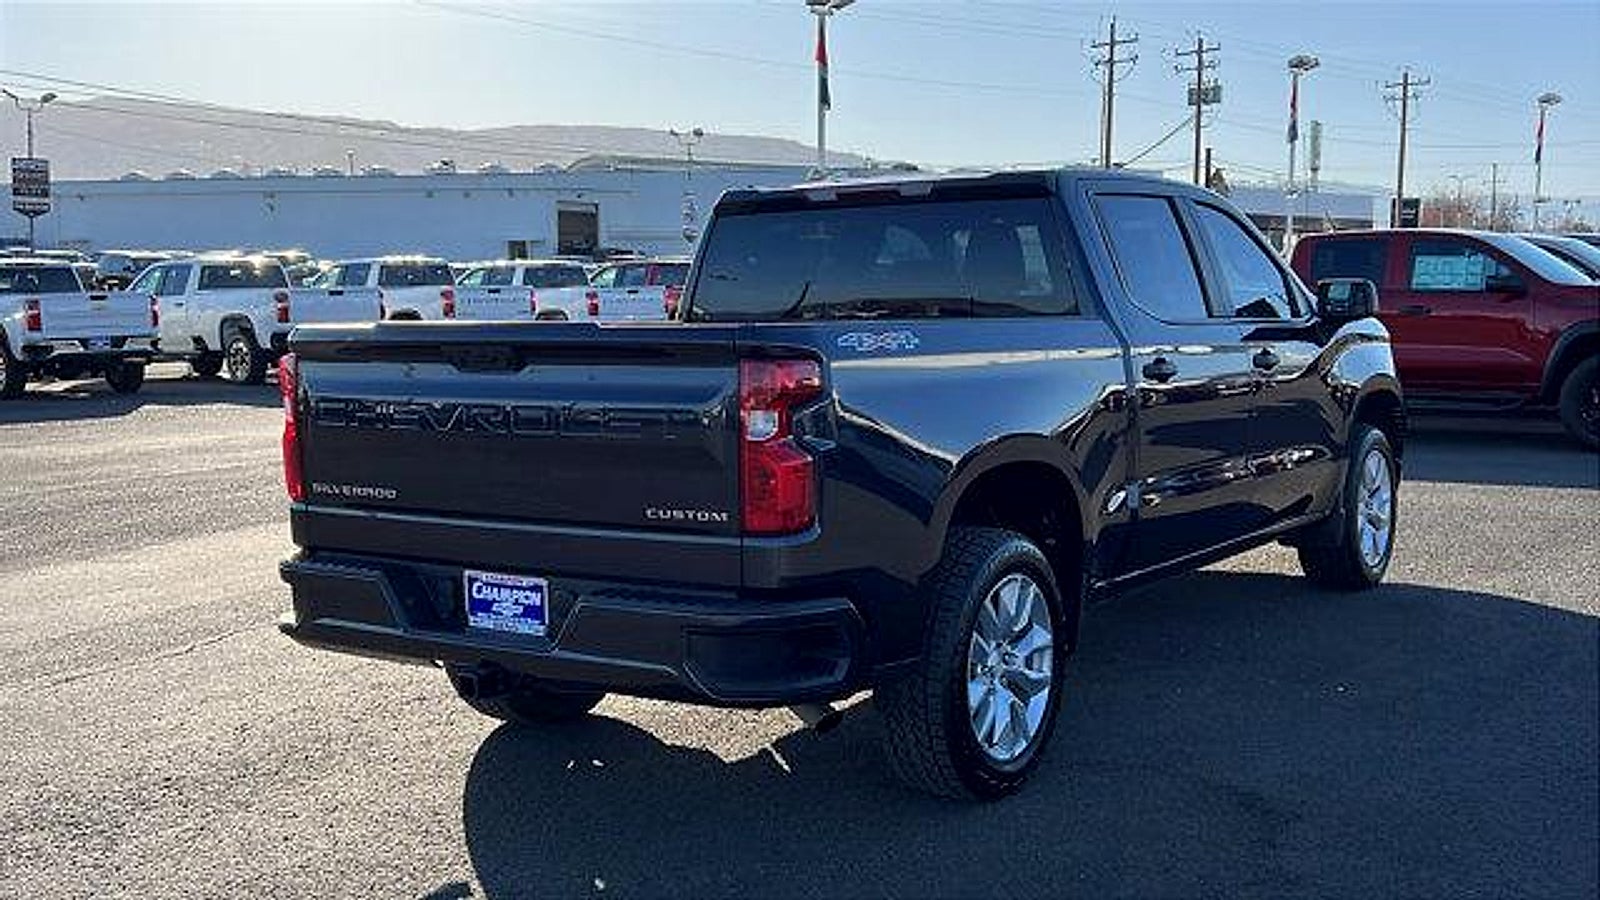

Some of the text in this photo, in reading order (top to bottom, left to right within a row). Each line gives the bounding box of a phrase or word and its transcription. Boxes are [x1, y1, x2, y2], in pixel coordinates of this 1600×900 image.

[312, 398, 679, 441] CHEVROLET
[311, 482, 397, 499] SILVERADO
[645, 507, 728, 521] CUSTOM
